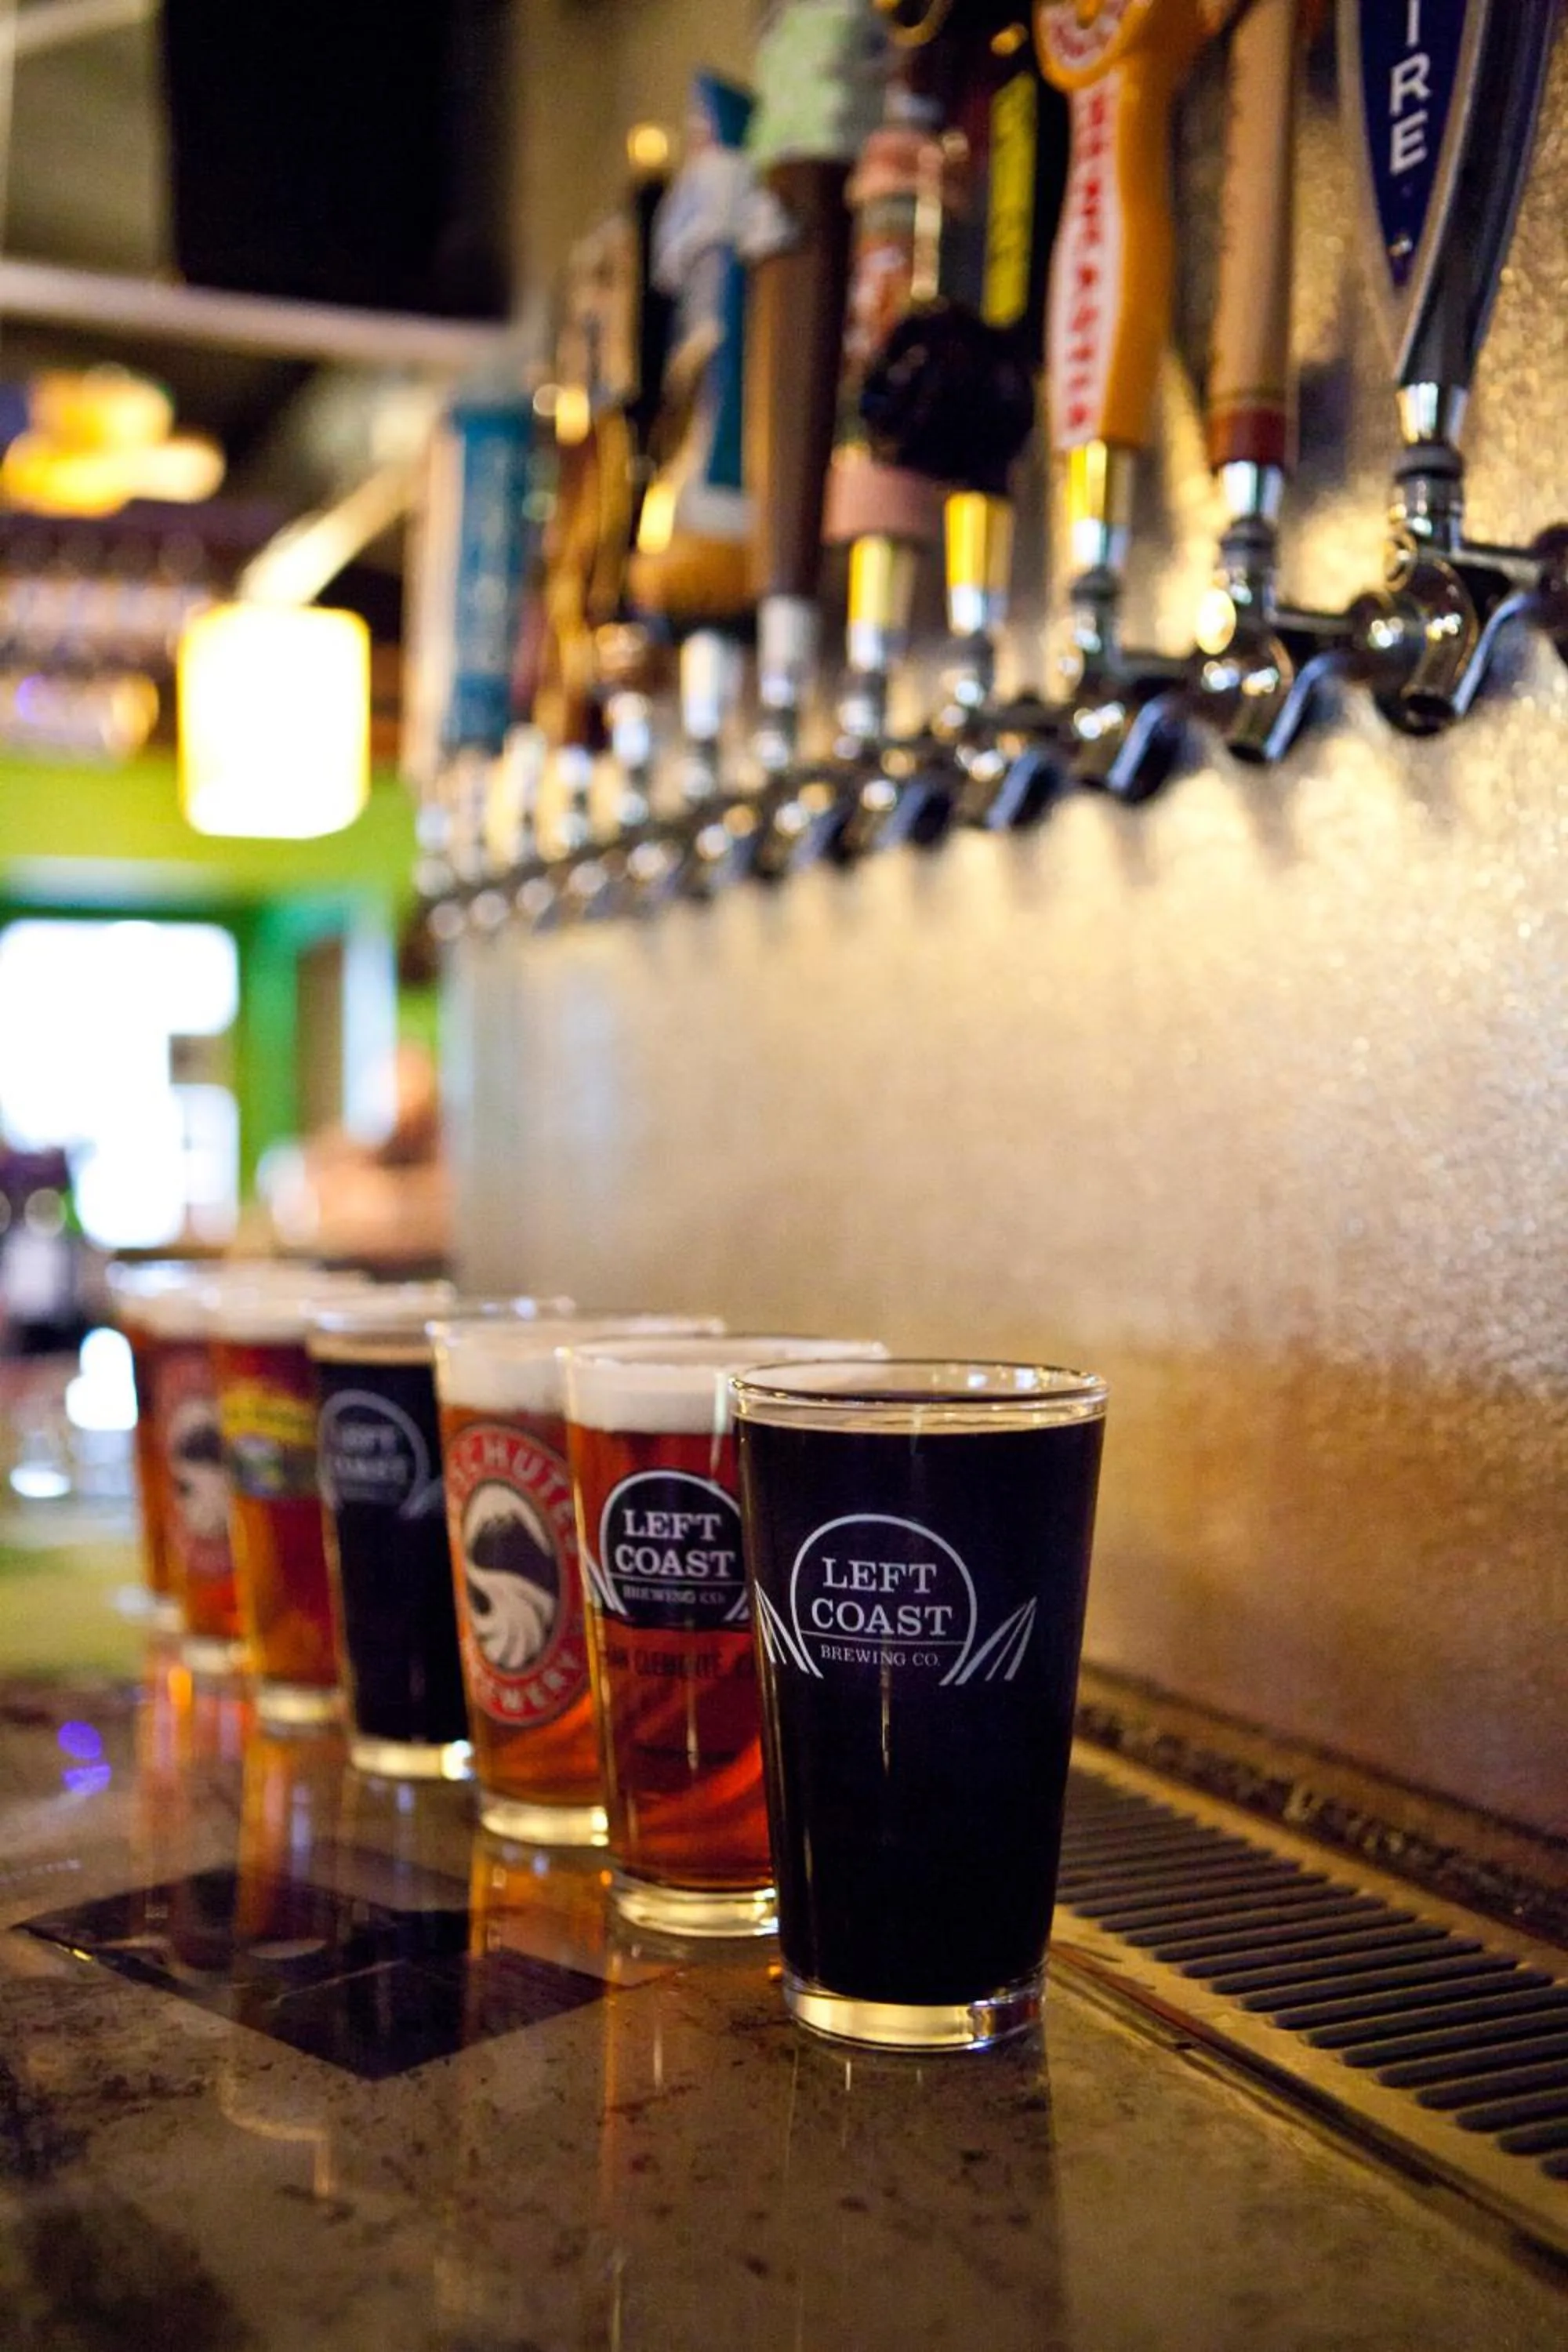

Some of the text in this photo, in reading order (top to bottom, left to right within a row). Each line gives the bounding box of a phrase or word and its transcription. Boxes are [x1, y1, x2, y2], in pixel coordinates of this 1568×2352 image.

[622, 1508, 722, 1541] LEFT
[615, 1543, 736, 1578] COAST
[822, 1556, 938, 1594] LEFT
[811, 1597, 953, 1637] COAST
[821, 1644, 942, 1668] BREWING CO.
